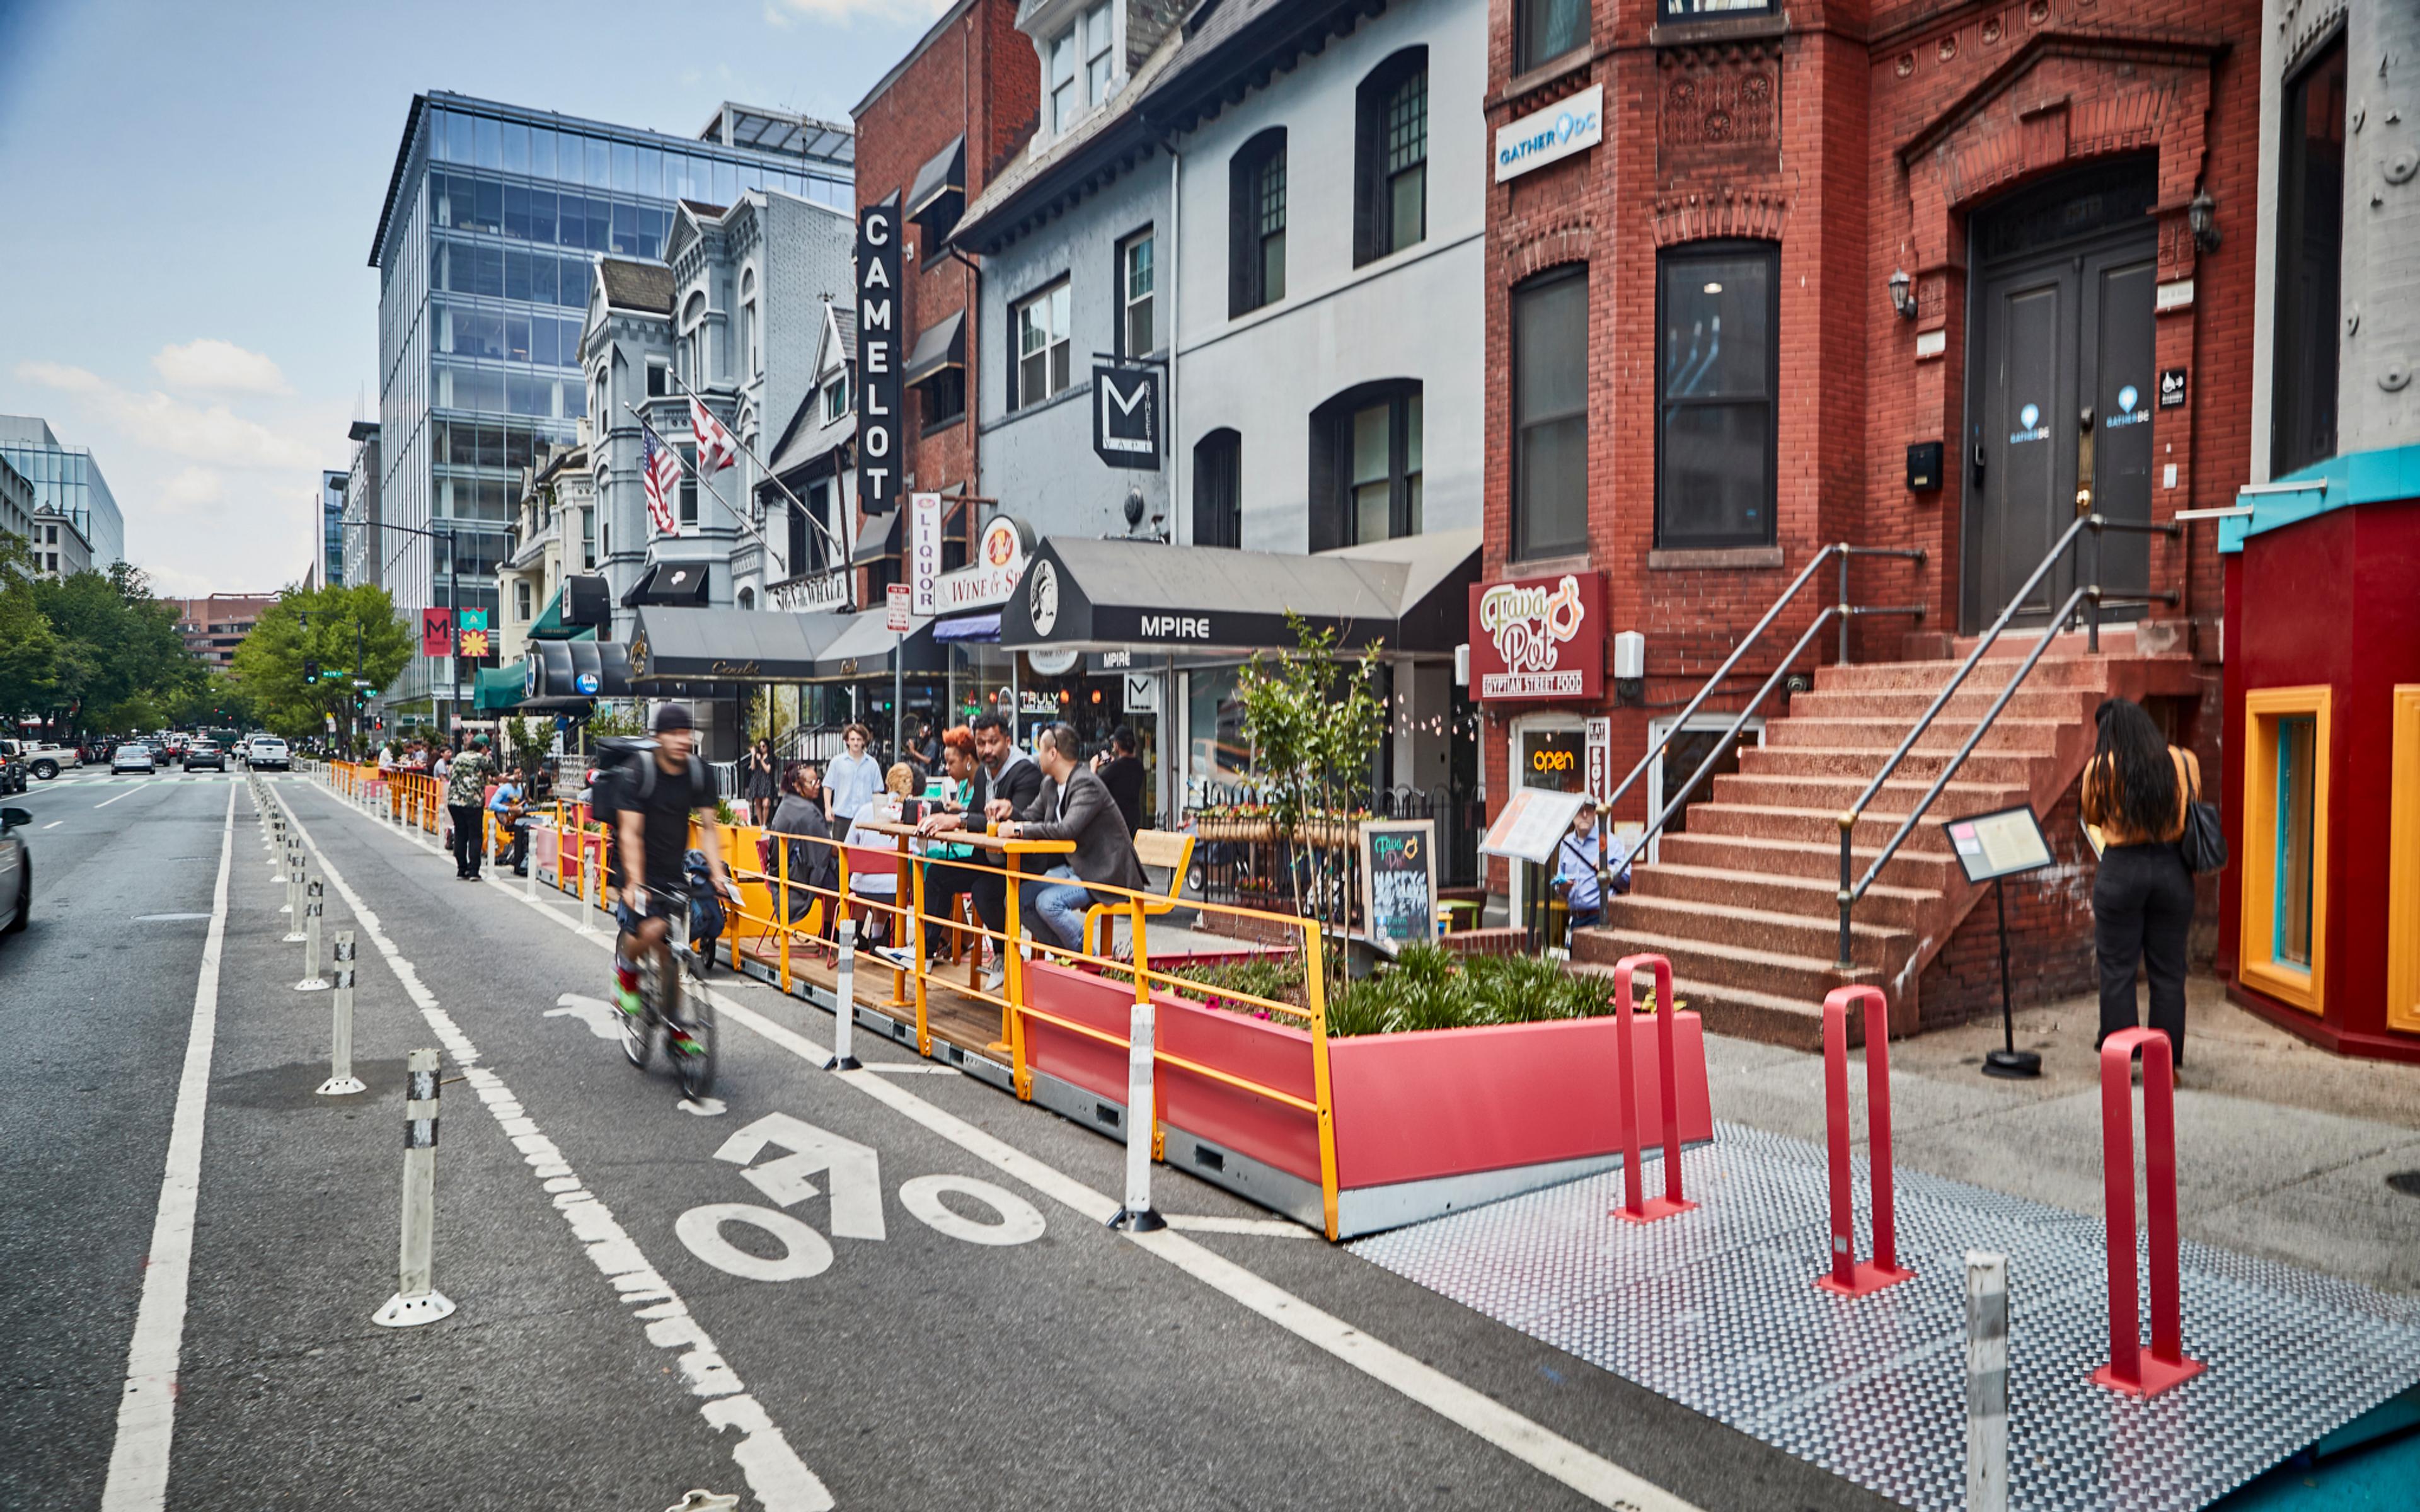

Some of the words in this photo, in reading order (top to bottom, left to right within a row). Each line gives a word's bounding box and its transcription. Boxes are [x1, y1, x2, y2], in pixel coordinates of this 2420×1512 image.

[1500, 130, 1555, 165] GATHER
[1574, 112, 1596, 136] DC
[864, 214, 890, 500] CAMELOT
[1104, 436, 1151, 452] VAPE
[919, 513, 933, 605] LIQUOR
[776, 585, 797, 612] SIGN
[804, 578, 844, 605] WHALE
[952, 578, 988, 603] WINE
[990, 570, 1001, 595] &
[426, 618, 448, 639] M
[1141, 616, 1210, 639] MPIRE
[1481, 587, 1549, 645] Fava
[1103, 651, 1131, 668] MPIRE
[1501, 622, 1558, 673] Pot
[1484, 677, 1522, 694] EGYPTIAN
[1524, 676, 1555, 693] STREET
[1557, 675, 1582, 692] FOOD
[1020, 691, 1059, 707] TRULY
[1589, 723, 1605, 735] EAT
[1533, 750, 1574, 775] open
